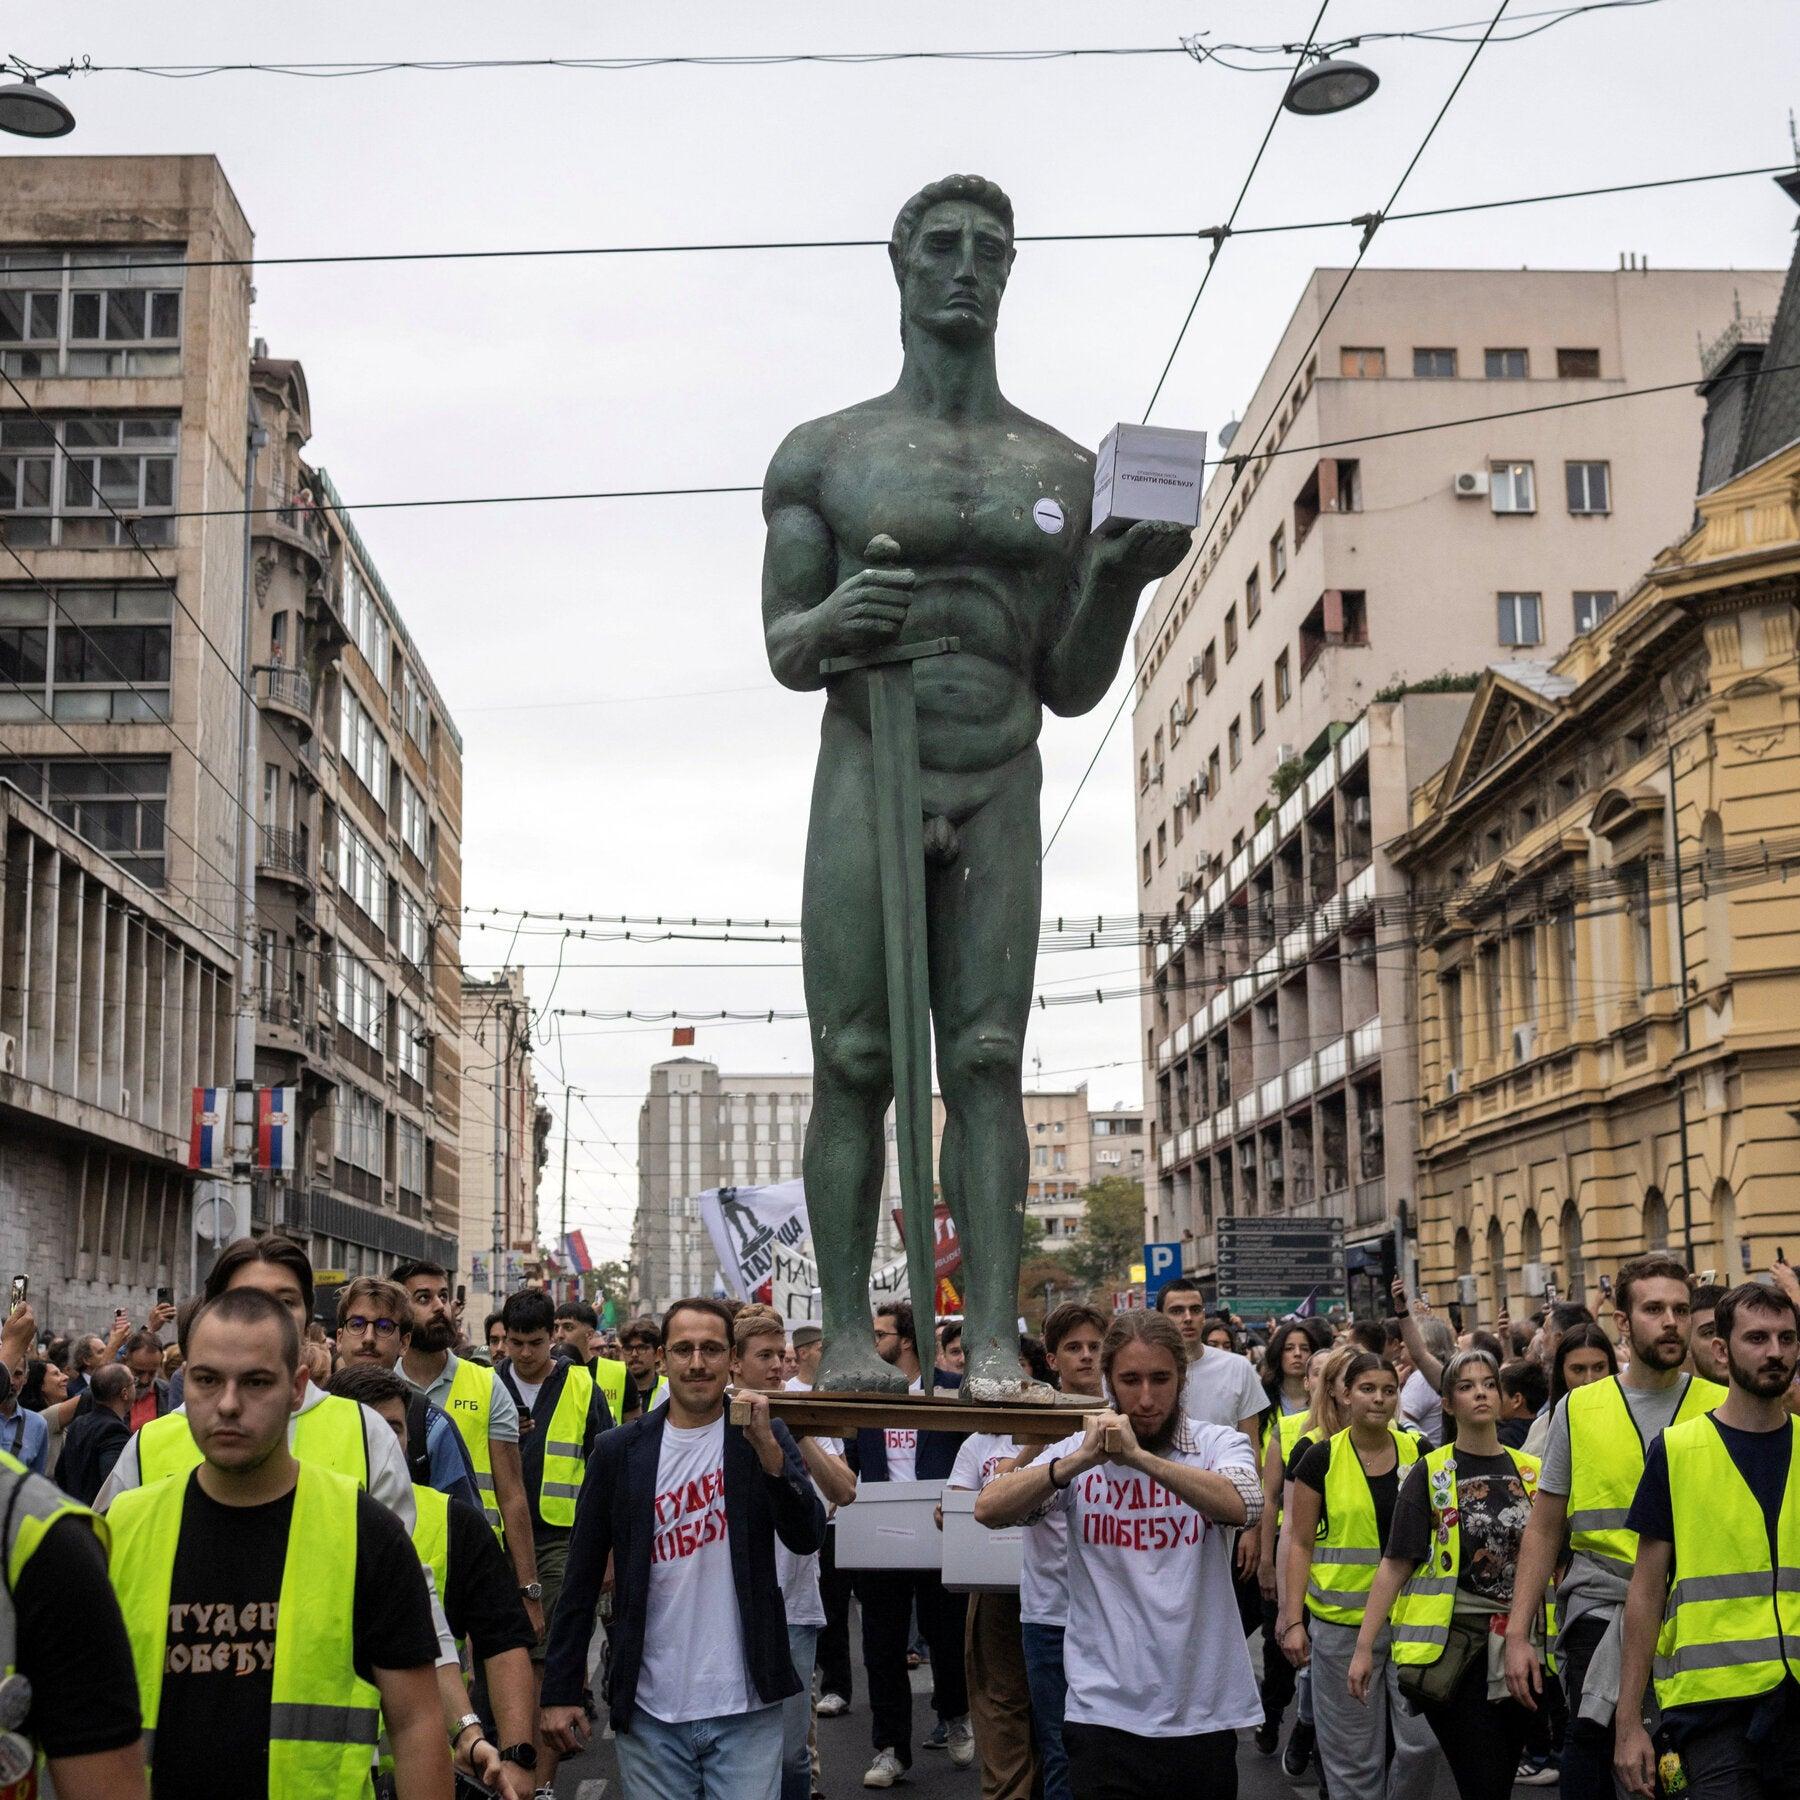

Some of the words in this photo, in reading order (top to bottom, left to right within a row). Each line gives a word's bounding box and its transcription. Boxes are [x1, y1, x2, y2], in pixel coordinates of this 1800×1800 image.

[1121, 474, 1158, 484] СТУДЕНТИ
[1158, 477, 1194, 488] ПОБЕЂУЈУ
[1152, 1247, 1174, 1276] P
[454, 1399, 478, 1411] РГБ
[655, 1468, 725, 1526] ТУДЕ
[169, 1601, 279, 1637] ТУДЕН
[164, 1640, 275, 1677] ОБЕЂУ
